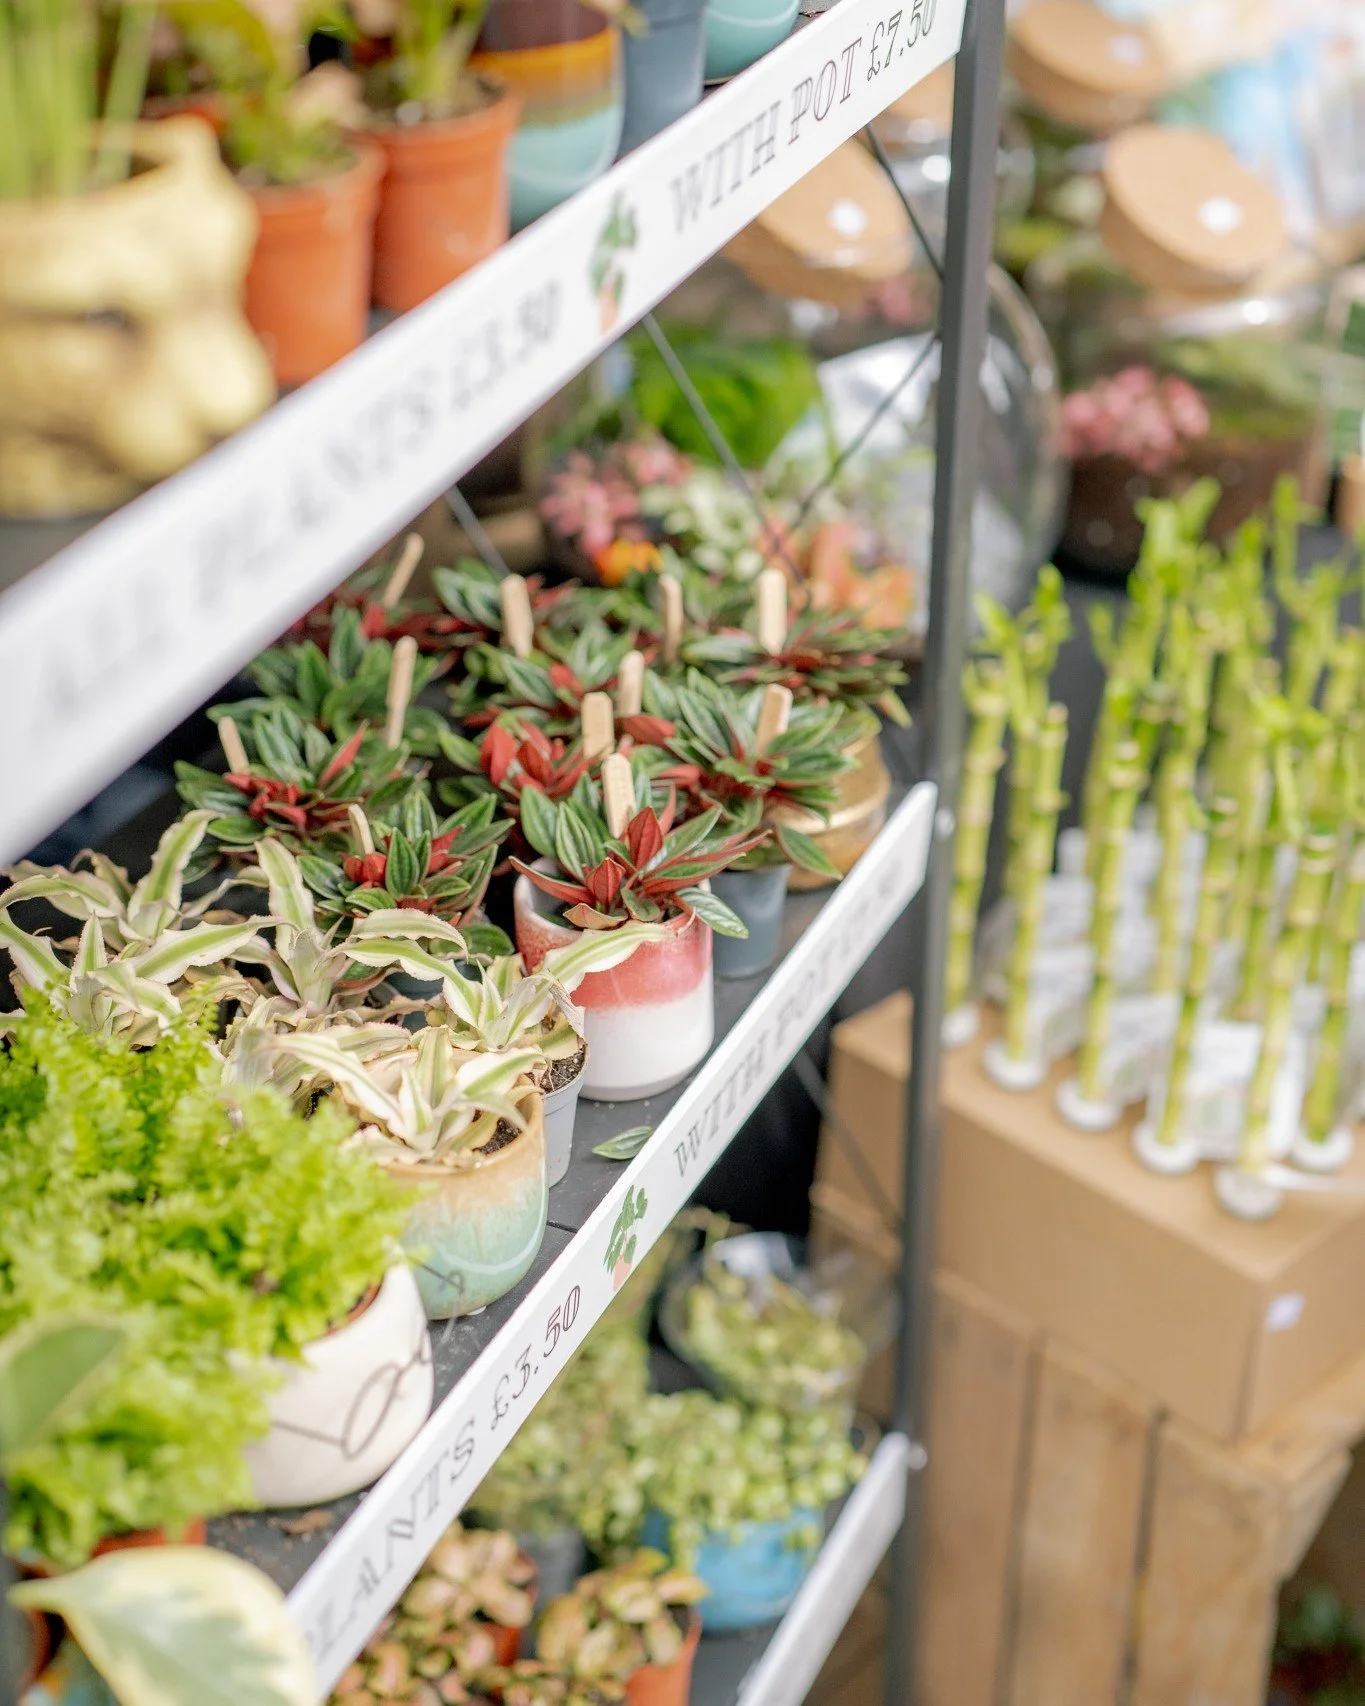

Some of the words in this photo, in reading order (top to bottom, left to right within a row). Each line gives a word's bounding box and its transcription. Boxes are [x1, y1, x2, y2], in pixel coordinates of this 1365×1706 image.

[669, 100, 781, 233] WITH
[788, 37, 862, 145] POT
[866, 0, 938, 81] £7.50
[303, 1416, 476, 1662] LANTS
[490, 1284, 581, 1431] £3.50
[673, 1028, 768, 1177] WITH
